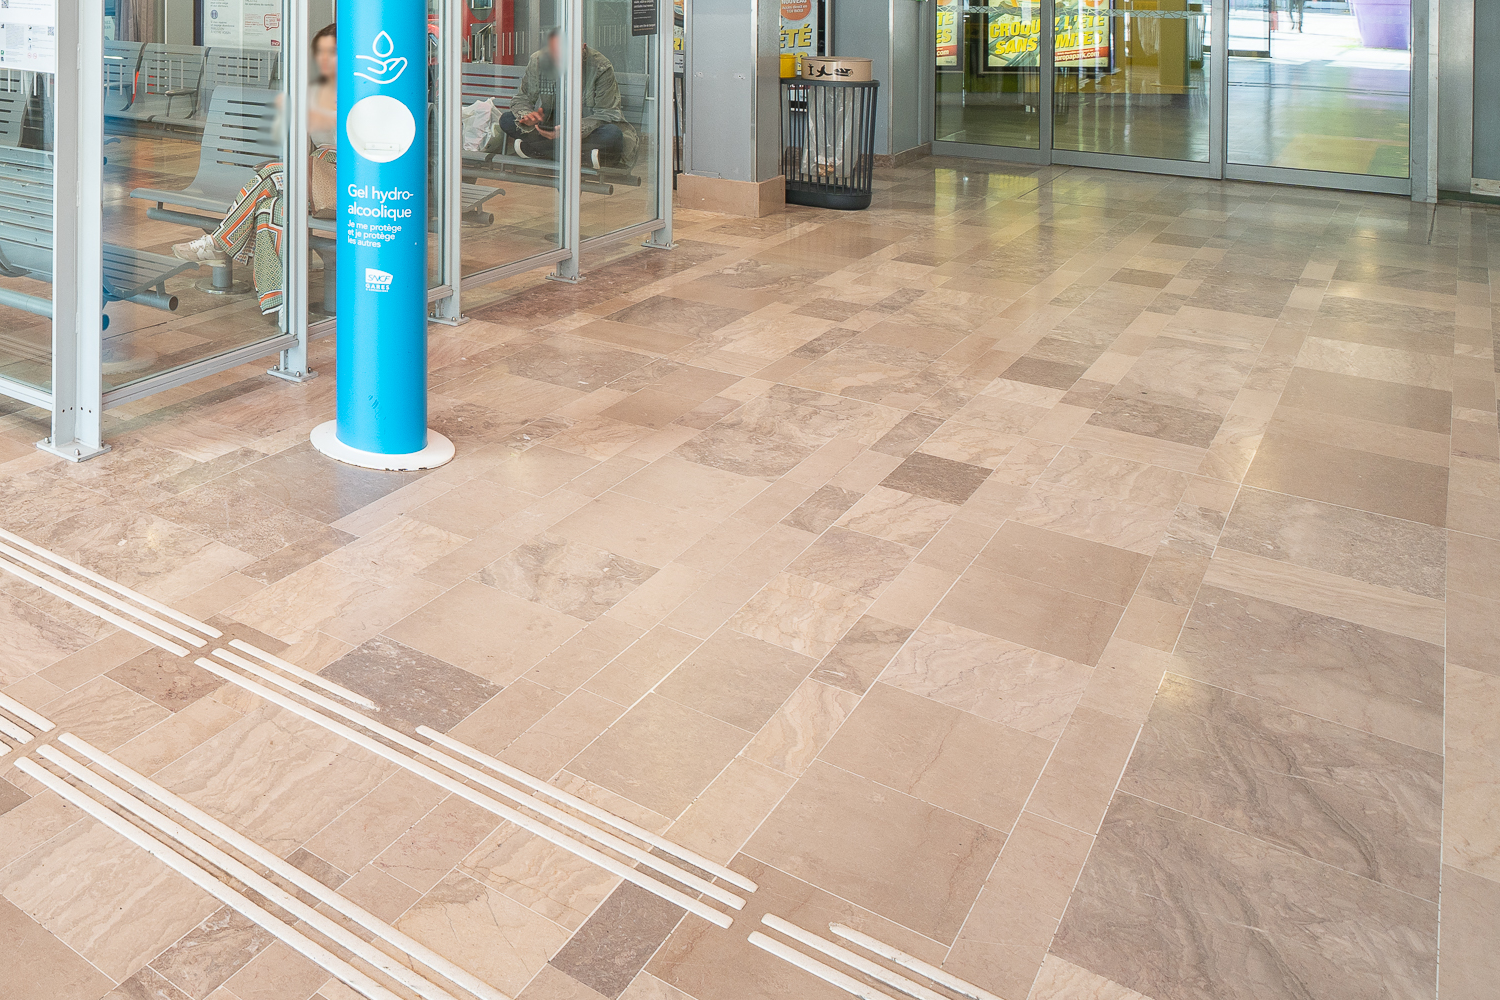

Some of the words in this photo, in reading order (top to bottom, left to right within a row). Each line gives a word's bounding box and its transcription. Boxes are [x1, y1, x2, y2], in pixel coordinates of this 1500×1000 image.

[994, 37, 1038, 55] SANS
[1056, 30, 1103, 49] MITES
[1055, 51, 1100, 62] uropapark.com
[348, 184, 368, 198] Gel
[372, 186, 414, 203] hydro-
[348, 202, 412, 221] alcoolique
[370, 224, 402, 233] protège
[348, 236, 356, 244] les
[357, 238, 381, 248] autres
[355, 230, 362, 238] je
[363, 231, 395, 242] protège
